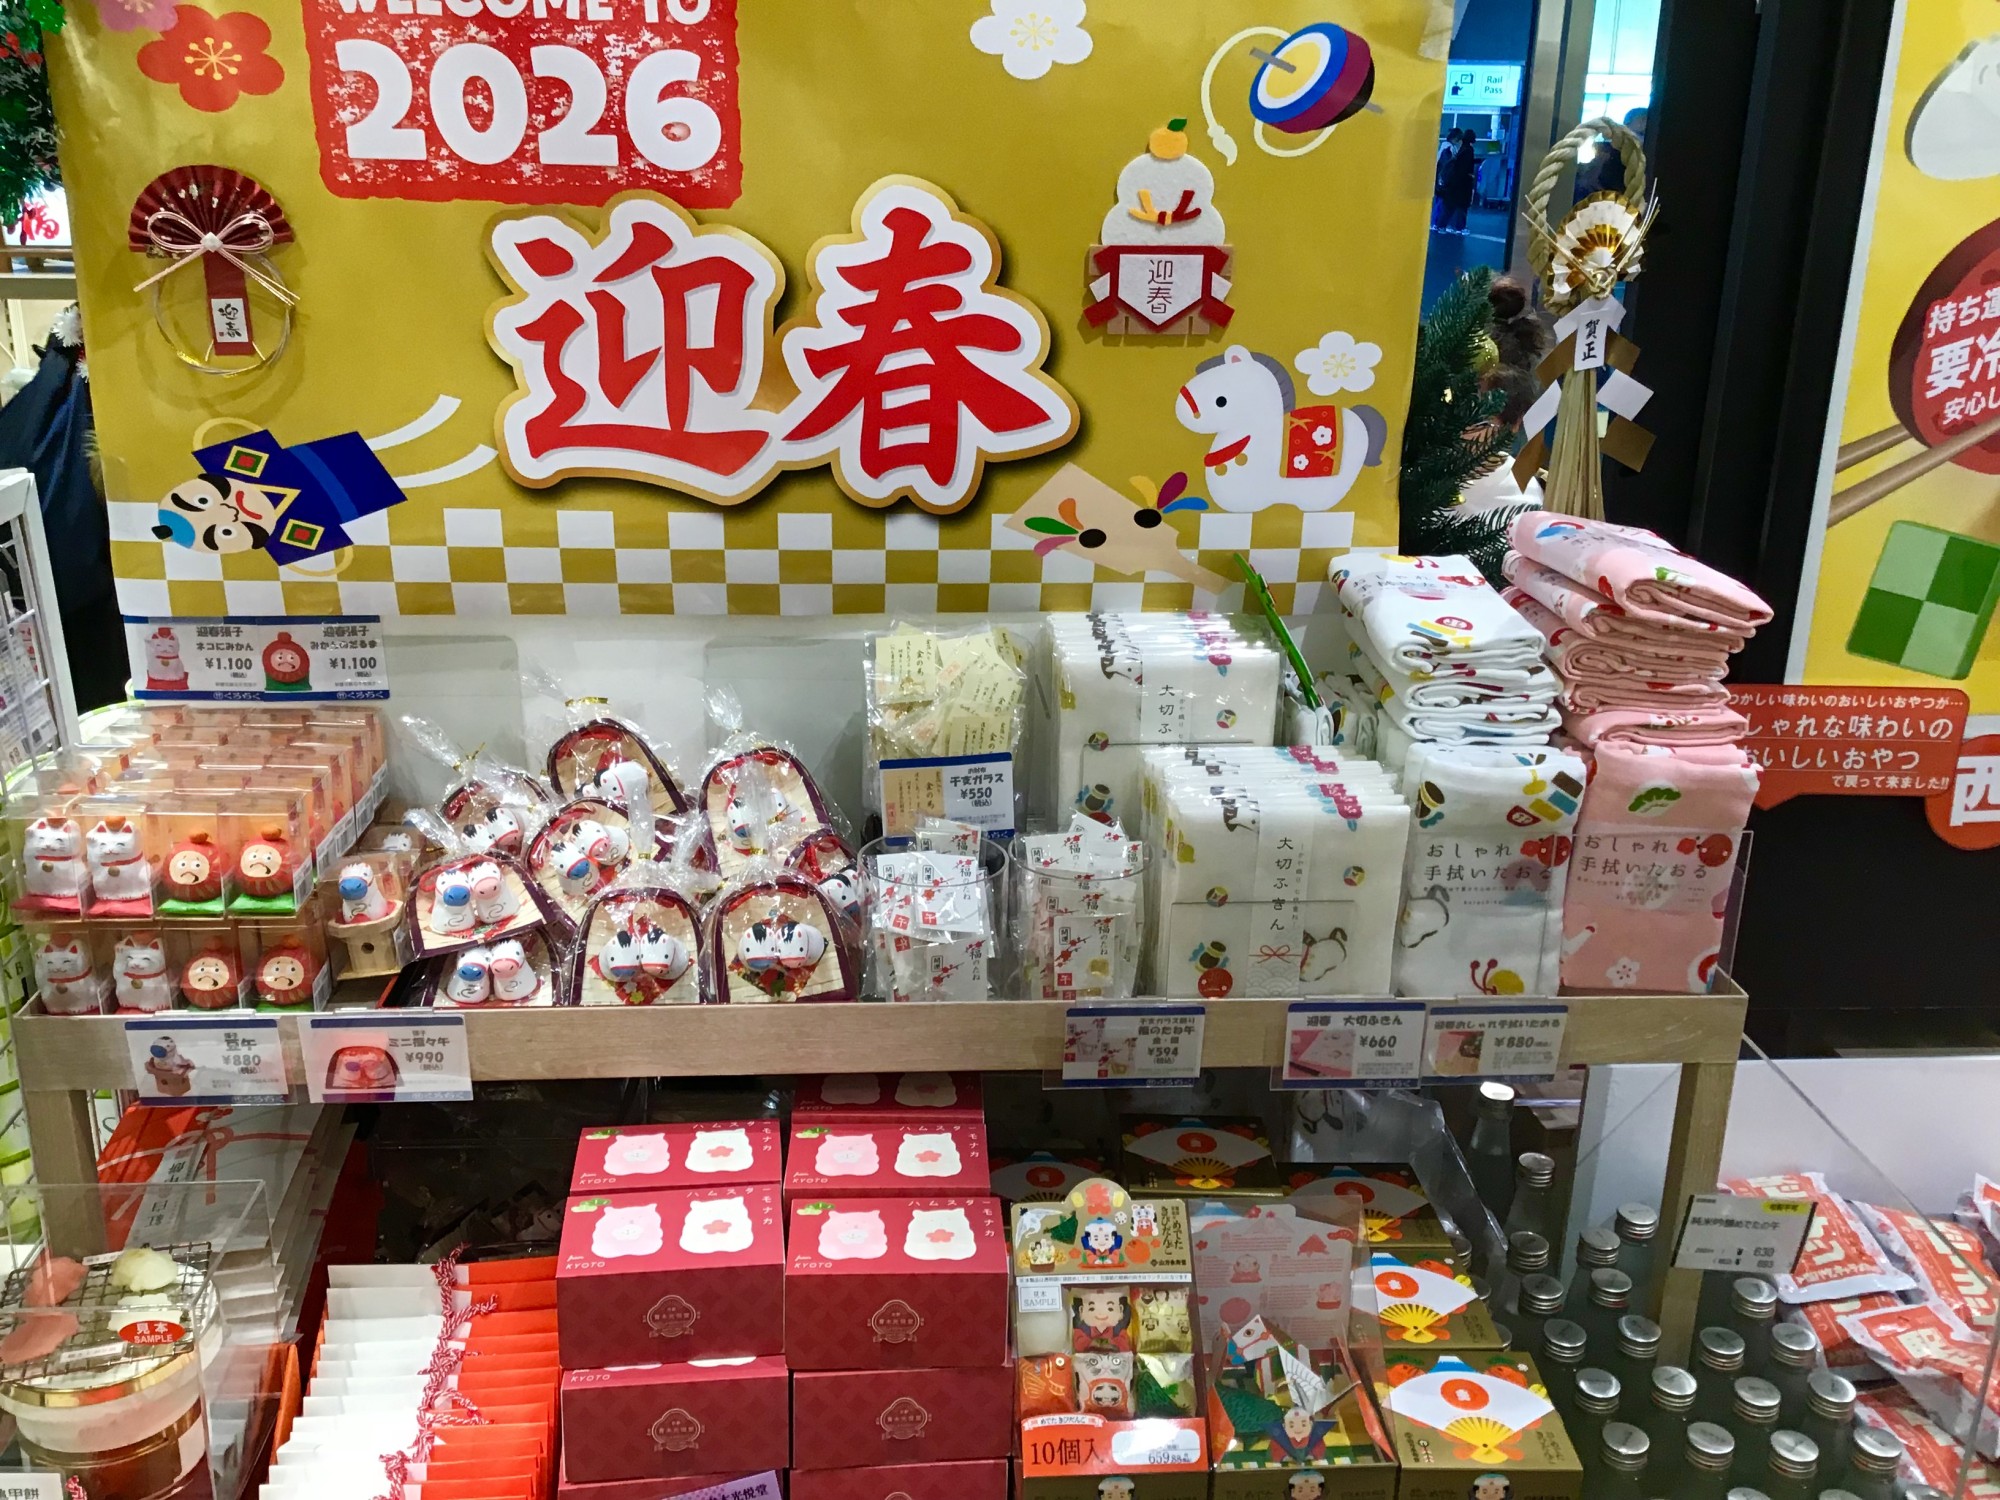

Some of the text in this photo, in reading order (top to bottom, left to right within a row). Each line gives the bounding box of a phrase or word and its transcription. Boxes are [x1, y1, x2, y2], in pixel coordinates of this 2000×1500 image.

[1486, 75, 1503, 84] Rail
[1484, 85, 1503, 95] Pass
[335, 38, 722, 171] 2026
[1147, 259, 1174, 314] 迎春
[1581, 318, 1601, 361] 賀正
[514, 207, 1052, 486] 迎春
[196, 626, 244, 638] 迎春張子
[322, 626, 370, 638] 迎春張子
[195, 641, 254, 652] ネコにみかん
[949, 773, 1005, 787] 干支ガラス
[960, 786, 993, 800] ¥550
[1426, 842, 1513, 859] おしゃれ
[1584, 835, 1670, 854] おしゃれ
[1423, 863, 1552, 882] 手拭いたおる
[1580, 855, 1707, 879] 手拭いたおる
[1269, 836, 1294, 931] 大切ふきん
[1342, 1014, 1404, 1027] 大切ふきん
[1358, 1034, 1398, 1049] ¥660
[1493, 1036, 1535, 1049] ¥880
[405, 1051, 444, 1063] ¥990
[1147, 1046, 1179, 1057] ¥594
[222, 1054, 262, 1067] ¥880
[579, 1177, 617, 1185] KYOTO
[565, 1261, 606, 1270] KYOTO
[793, 1261, 833, 1269] KYOTO
[1024, 1298, 1058, 1307] SAMPLE
[136, 1322, 168, 1335] 見本
[134, 1334, 173, 1344] SAMPLE
[570, 1374, 611, 1383] KYOTO
[1031, 1437, 1105, 1466] 10個入
